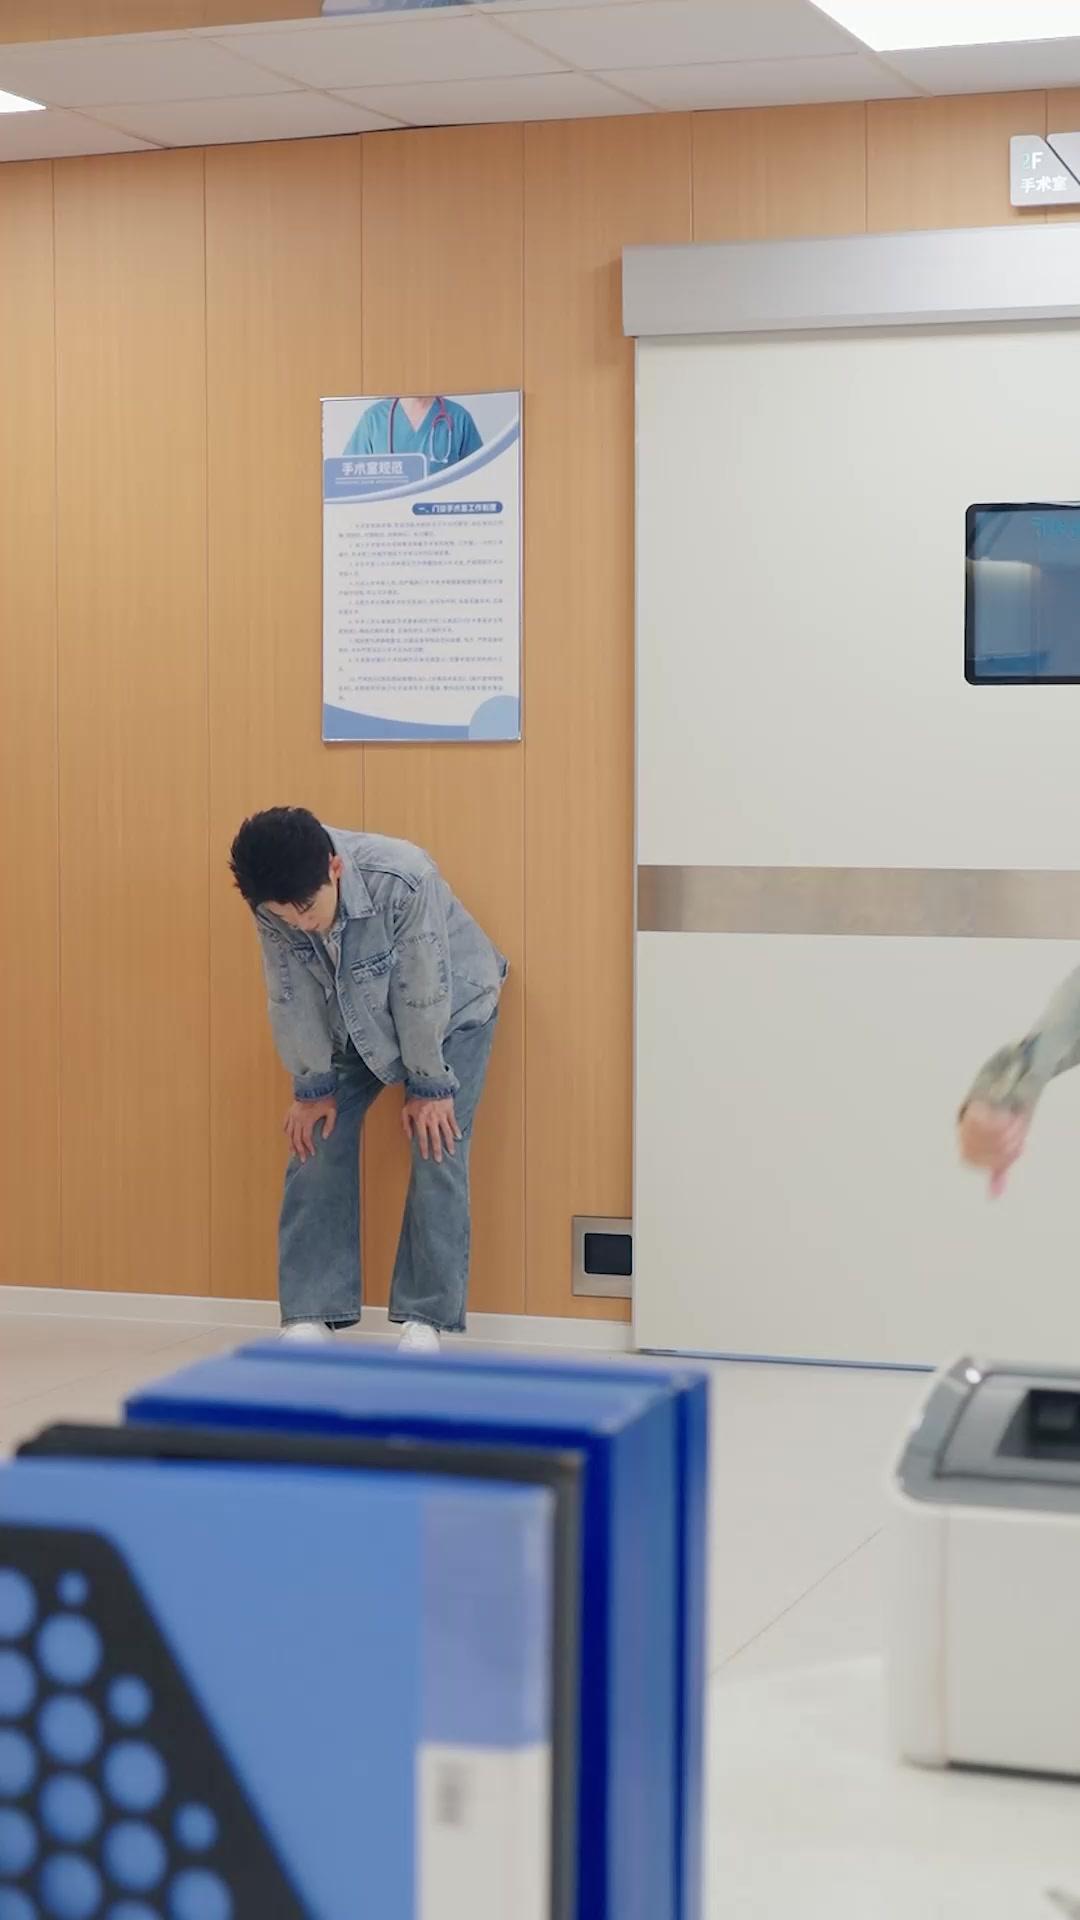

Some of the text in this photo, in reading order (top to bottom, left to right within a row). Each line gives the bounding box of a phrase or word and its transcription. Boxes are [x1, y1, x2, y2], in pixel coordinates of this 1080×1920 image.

[1020, 175, 1068, 194] 手术室
[341, 460, 404, 477] 手术室规范
